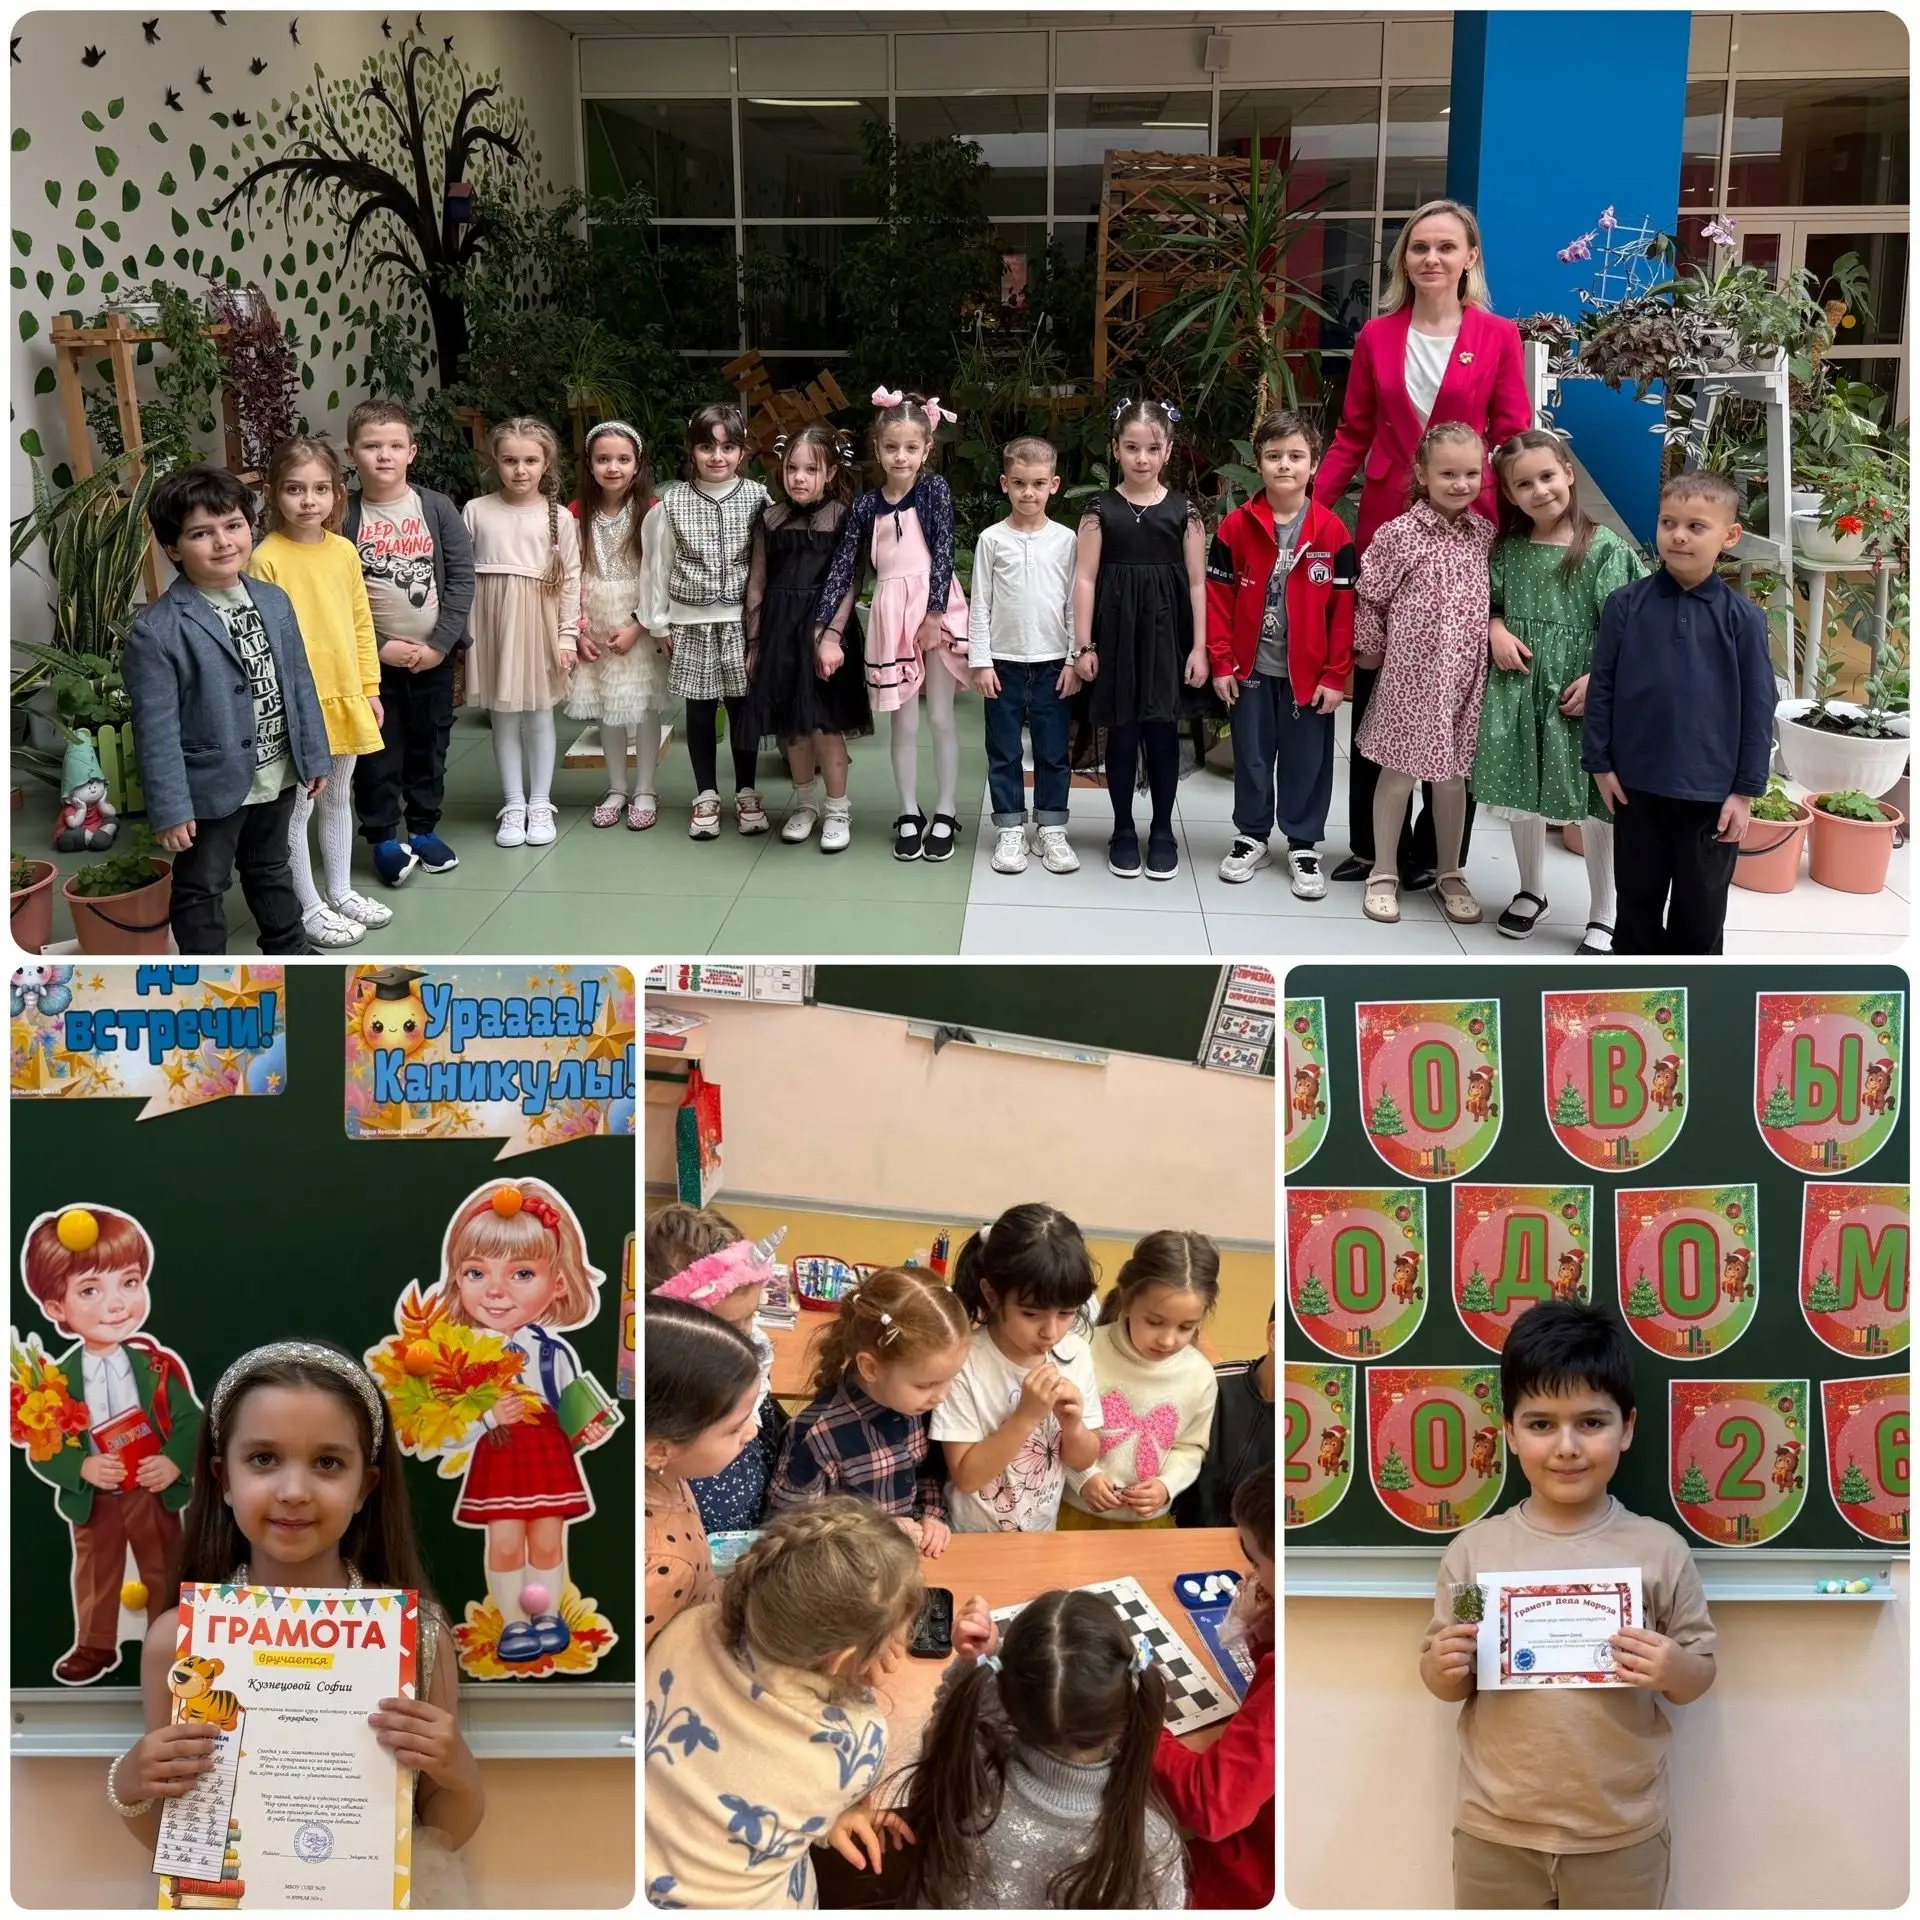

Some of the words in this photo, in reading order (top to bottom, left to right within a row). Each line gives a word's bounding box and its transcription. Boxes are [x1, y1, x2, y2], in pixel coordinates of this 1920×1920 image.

[401, 518, 421, 534] ON
[373, 536, 433, 557] PLAYING
[420, 981, 599, 1053] Ураааа!
[65, 991, 277, 1065] встречи!
[374, 1045, 636, 1115] Каникулы!
[1514, 1600, 1552, 1618] Грамота
[1555, 1597, 1580, 1605] Деда
[1583, 1599, 1617, 1615] Мороза
[206, 1615, 387, 1650] ГРАМОТА
[258, 1653, 329, 1666] вручается
[247, 1678, 311, 1692] Кузнецовой
[316, 1680, 353, 1694] Софии
